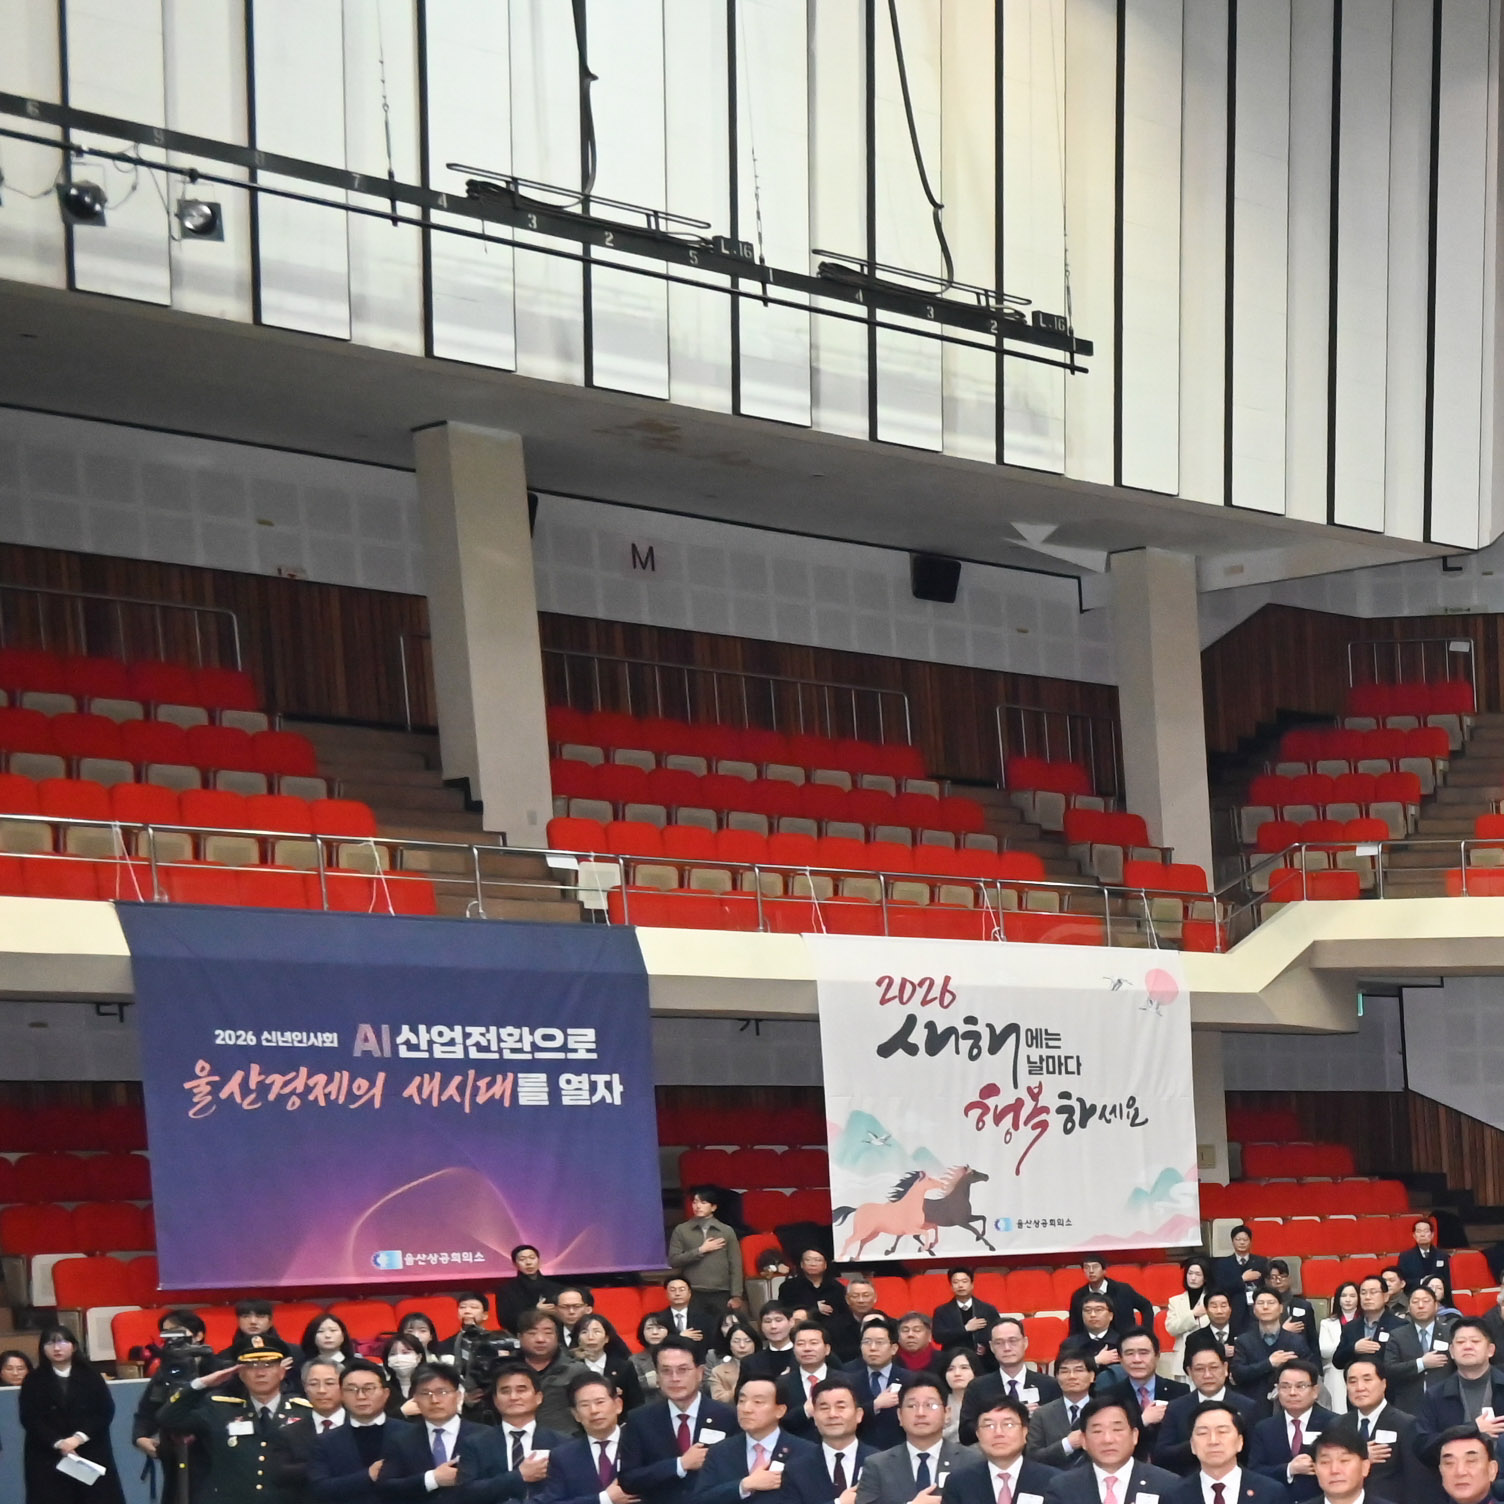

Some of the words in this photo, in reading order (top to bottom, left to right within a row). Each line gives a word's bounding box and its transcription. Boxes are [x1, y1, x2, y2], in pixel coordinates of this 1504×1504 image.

[352, 173, 361, 189] 7
[437, 193, 448, 209] 4
[527, 213, 538, 229] 3
[604, 230, 615, 247] 2
[688, 249, 699, 265] 5
[926, 305, 935, 320] 3
[990, 320, 999, 334] 2
[631, 542, 656, 572] M
[1442, 556, 1463, 572] L
[875, 975, 957, 1009] 2026
[214, 1029, 257, 1047] 2026
[261, 1030, 338, 1048] 신년인사회
[1026, 1055, 1082, 1076] 날마다
[183, 1059, 386, 1118] 울산경제의
[402, 1070, 549, 1113] 새시대를
[559, 1073, 624, 1105] 열자
[1016, 1218, 1073, 1230] 울산상공회의소
[404, 1252, 486, 1266] 울산상공회의소
